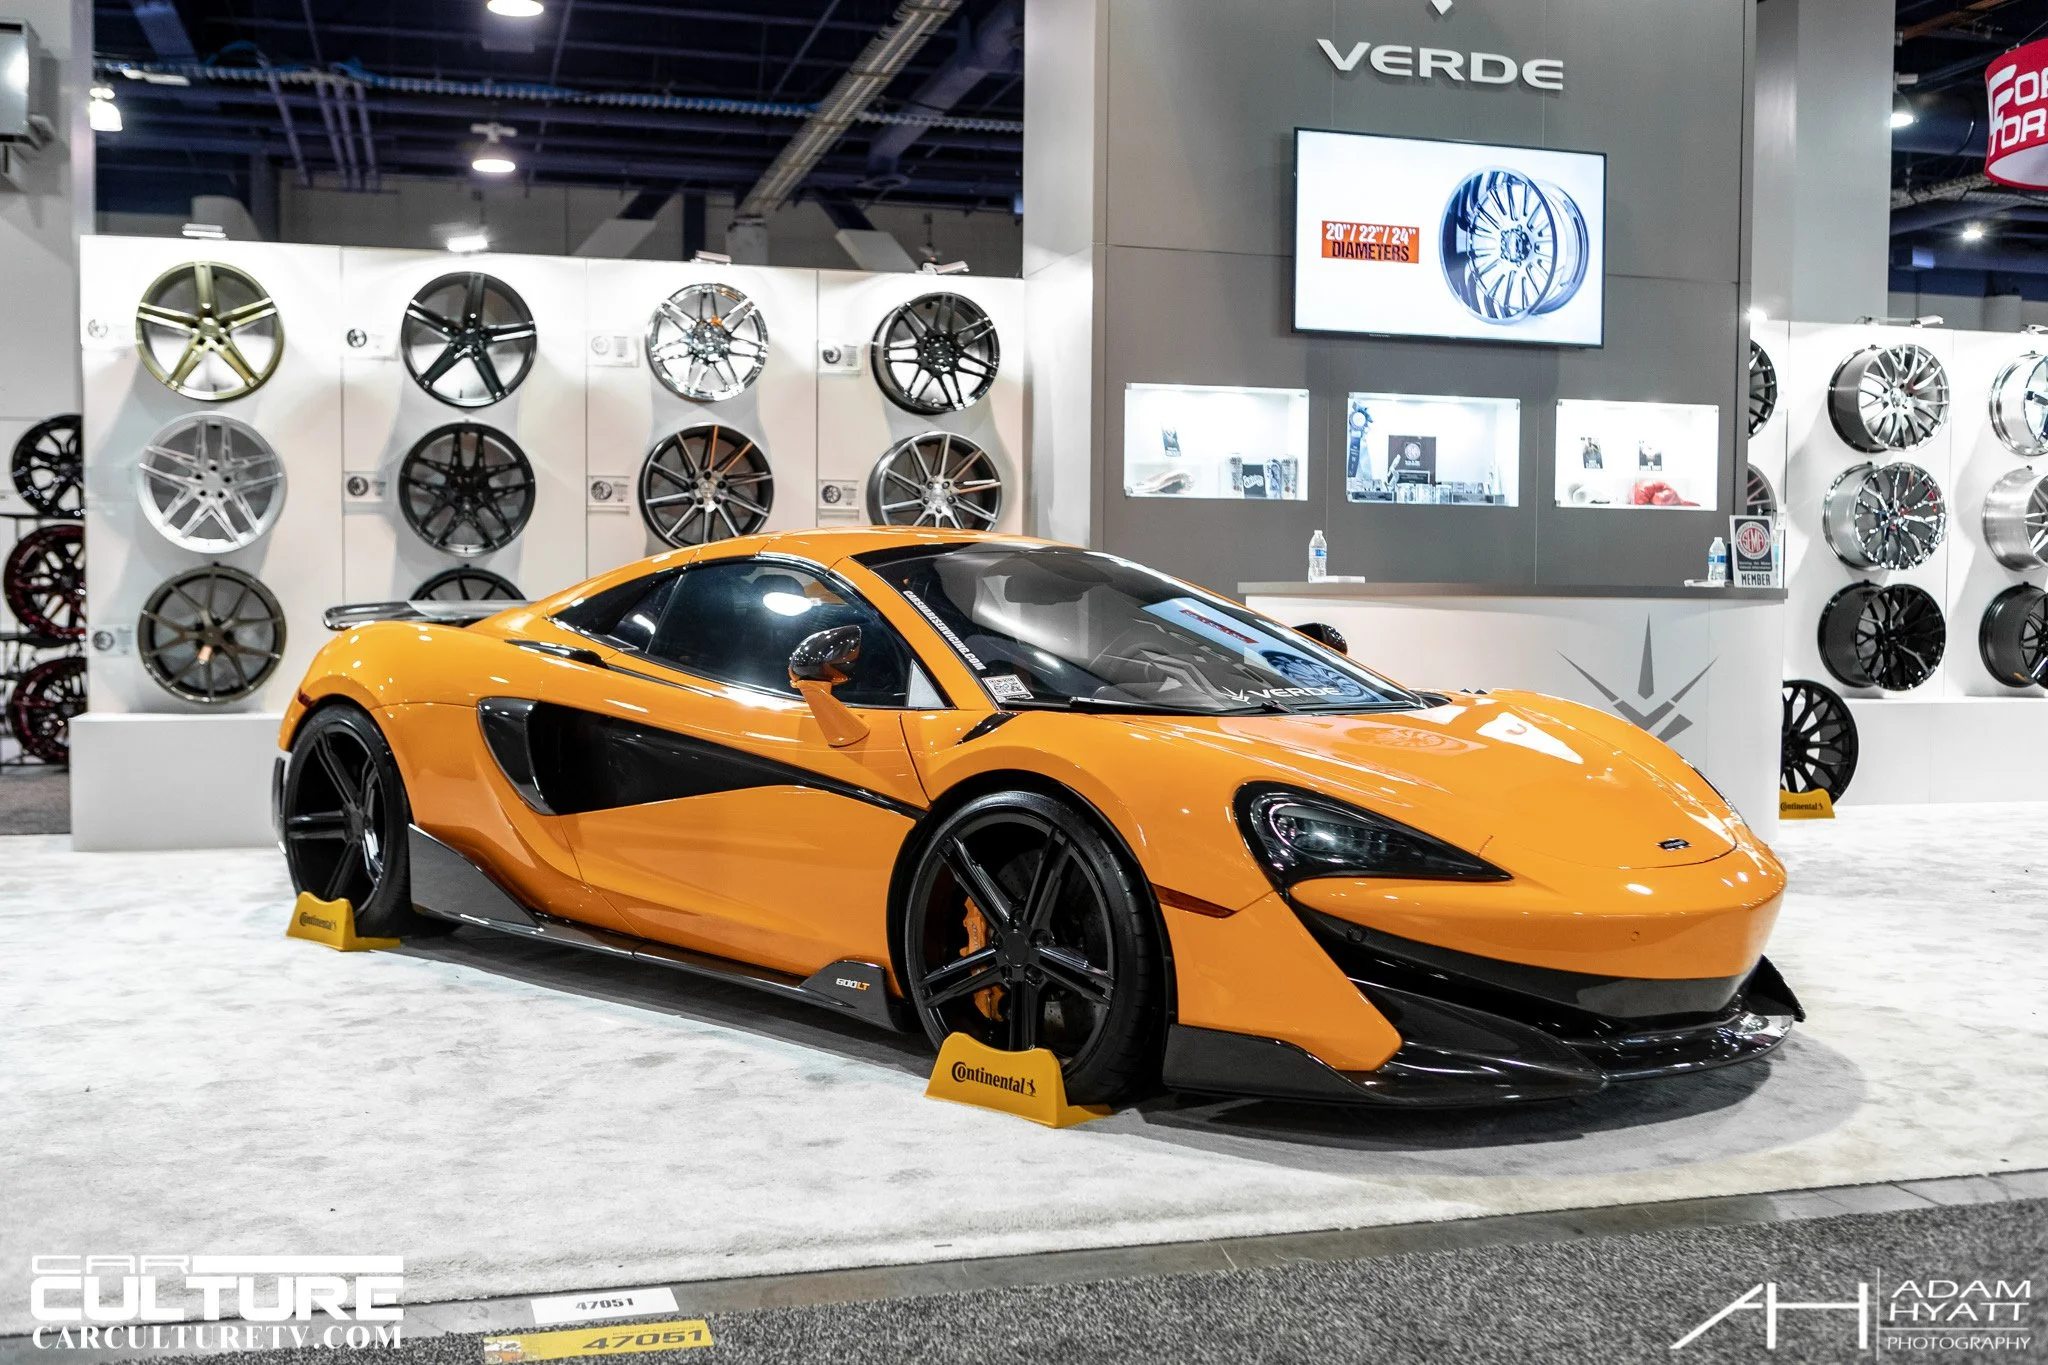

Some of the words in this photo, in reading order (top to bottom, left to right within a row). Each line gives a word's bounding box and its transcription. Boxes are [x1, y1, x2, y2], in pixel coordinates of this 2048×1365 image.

[1316, 38, 1564, 90] VERDE
[1332, 241, 1410, 262] DIAMETERS
[1741, 527, 1766, 554] SEMA
[1741, 573, 1771, 586] MEMBER
[903, 590, 987, 671] CARSHARESERVICING.COM
[1247, 687, 1344, 699] VERDE
[1780, 802, 1818, 812] Continental
[835, 977, 870, 991] 600LT
[951, 1061, 1025, 1094] Continental
[575, 1297, 634, 1310] 47051
[582, 1329, 702, 1350] 47051
